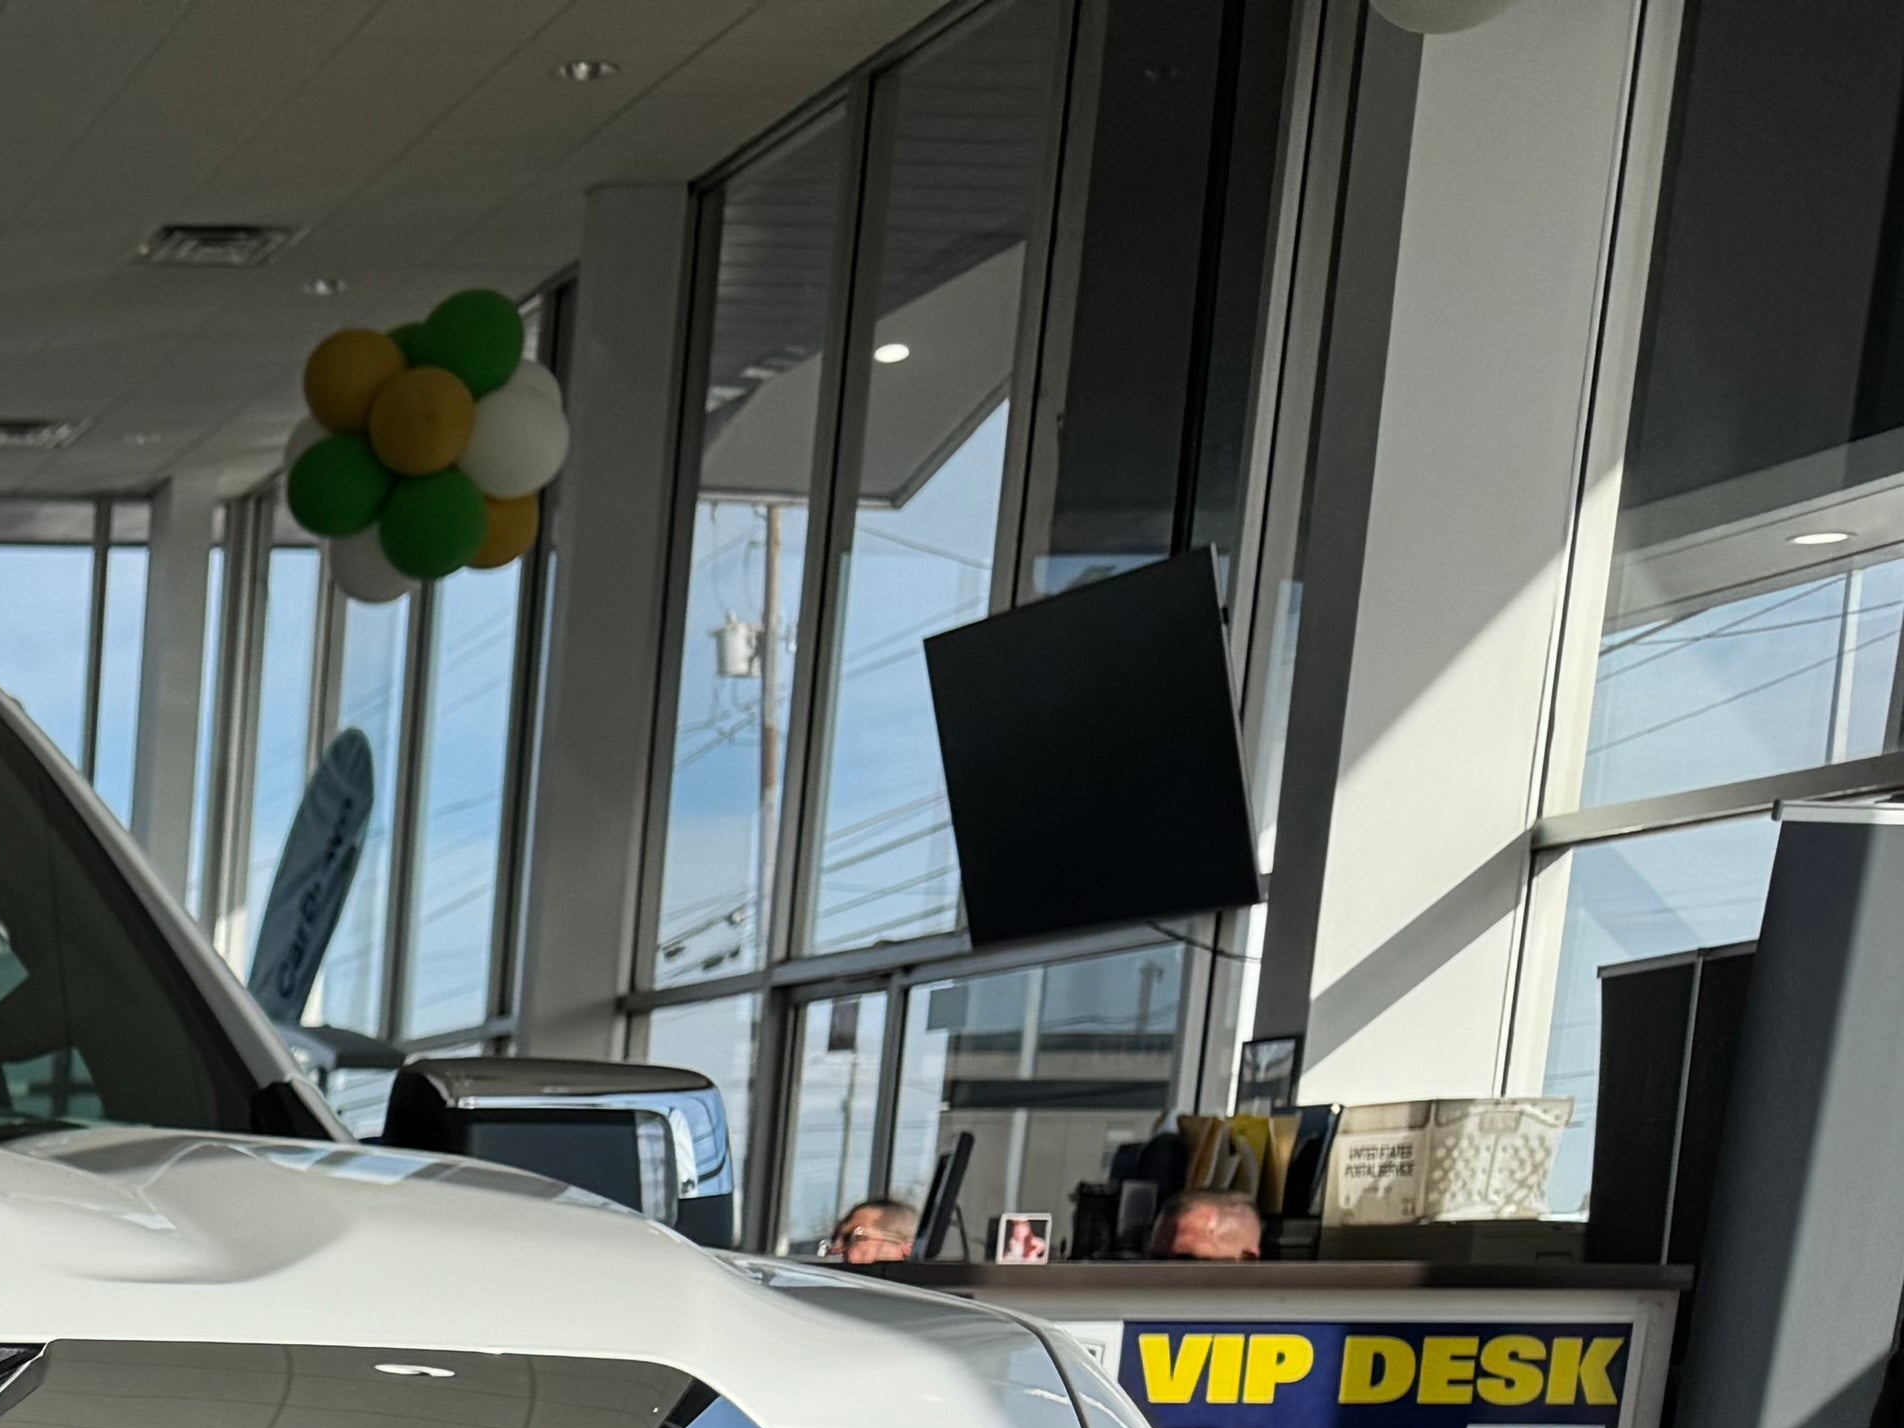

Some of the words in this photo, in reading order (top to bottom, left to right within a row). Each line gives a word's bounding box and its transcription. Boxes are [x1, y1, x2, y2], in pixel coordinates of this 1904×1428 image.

[1379, 1143, 1413, 1159] STATES
[1345, 1164, 1376, 1179] POSTAL
[1138, 1333, 1314, 1404] VIP
[1338, 1335, 1625, 1406] DESK
